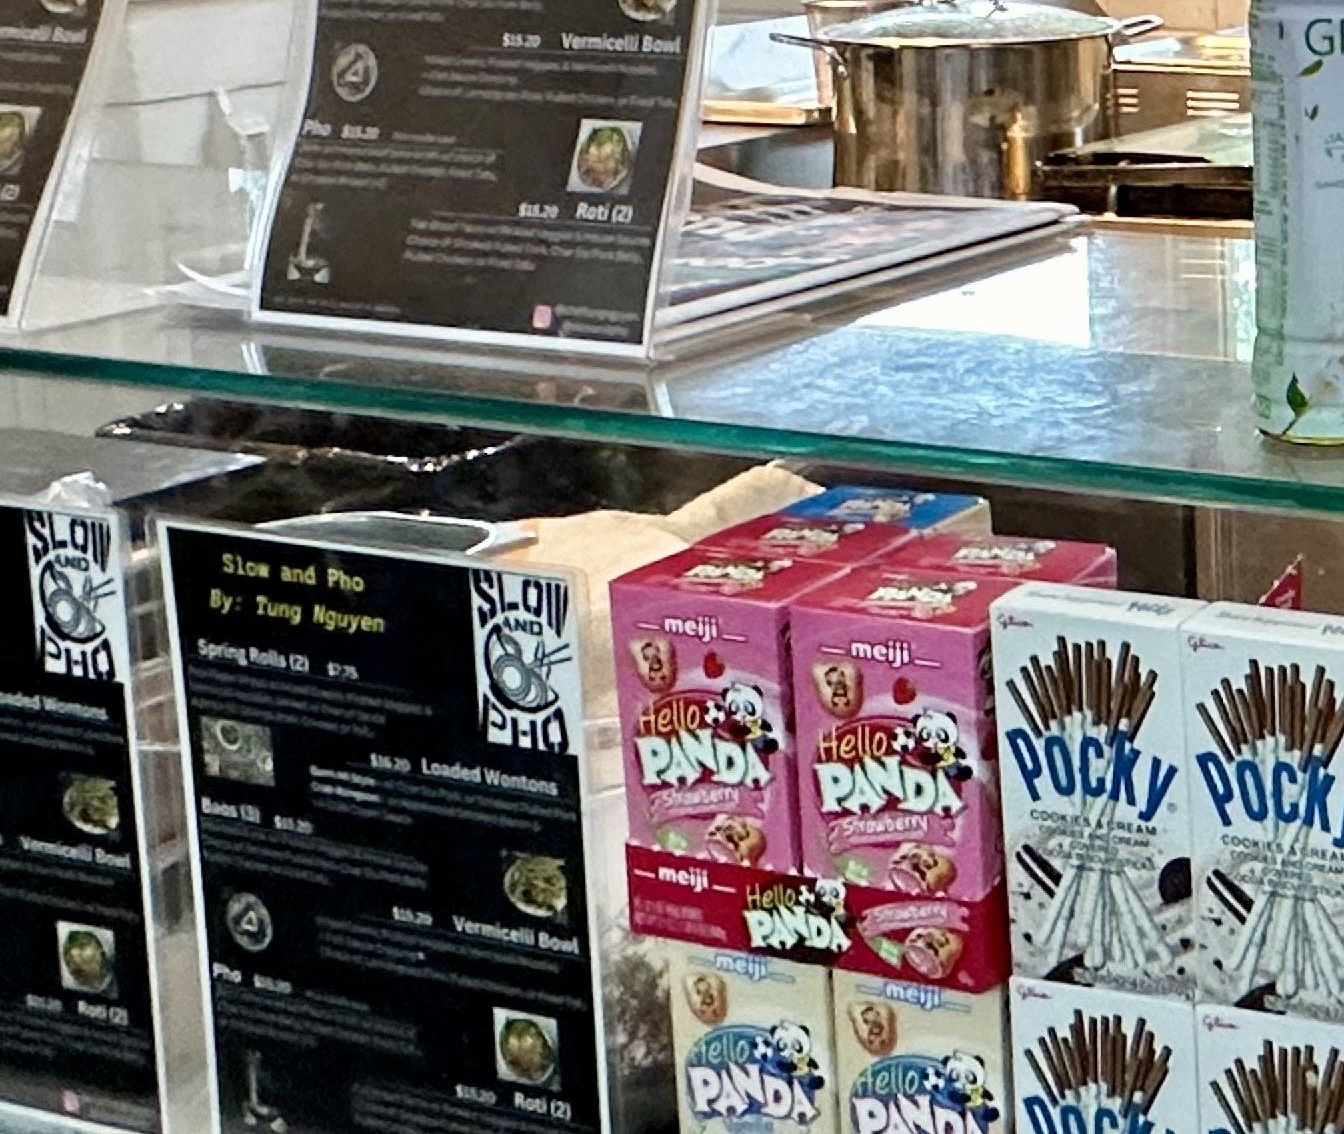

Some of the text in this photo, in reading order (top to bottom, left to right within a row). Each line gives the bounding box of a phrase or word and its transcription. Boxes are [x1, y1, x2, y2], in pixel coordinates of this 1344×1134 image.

[561, 32, 682, 56] Vermicelli Bowl
[575, 201, 609, 222] Roti
[222, 552, 365, 592] Slow and Pho
[256, 596, 386, 634] Tung Nguyen
[503, 617, 543, 637] AND
[664, 616, 718, 643] meiji
[851, 640, 910, 667] meiji
[638, 705, 700, 736] Hello
[634, 730, 772, 789] PANDA
[818, 728, 888, 760] Hello
[421, 758, 559, 797] Loaded Wontons
[815, 756, 967, 816] PANDA
[1006, 725, 1178, 823] POCKY
[658, 866, 709, 893] meiji
[746, 883, 797, 910] Hello
[452, 915, 580, 955] Vermicelli Bowl
[744, 905, 853, 954] PANDA
[715, 953, 768, 981] meiji
[886, 982, 944, 1010] meiji
[688, 1061, 819, 1125] PANDA
